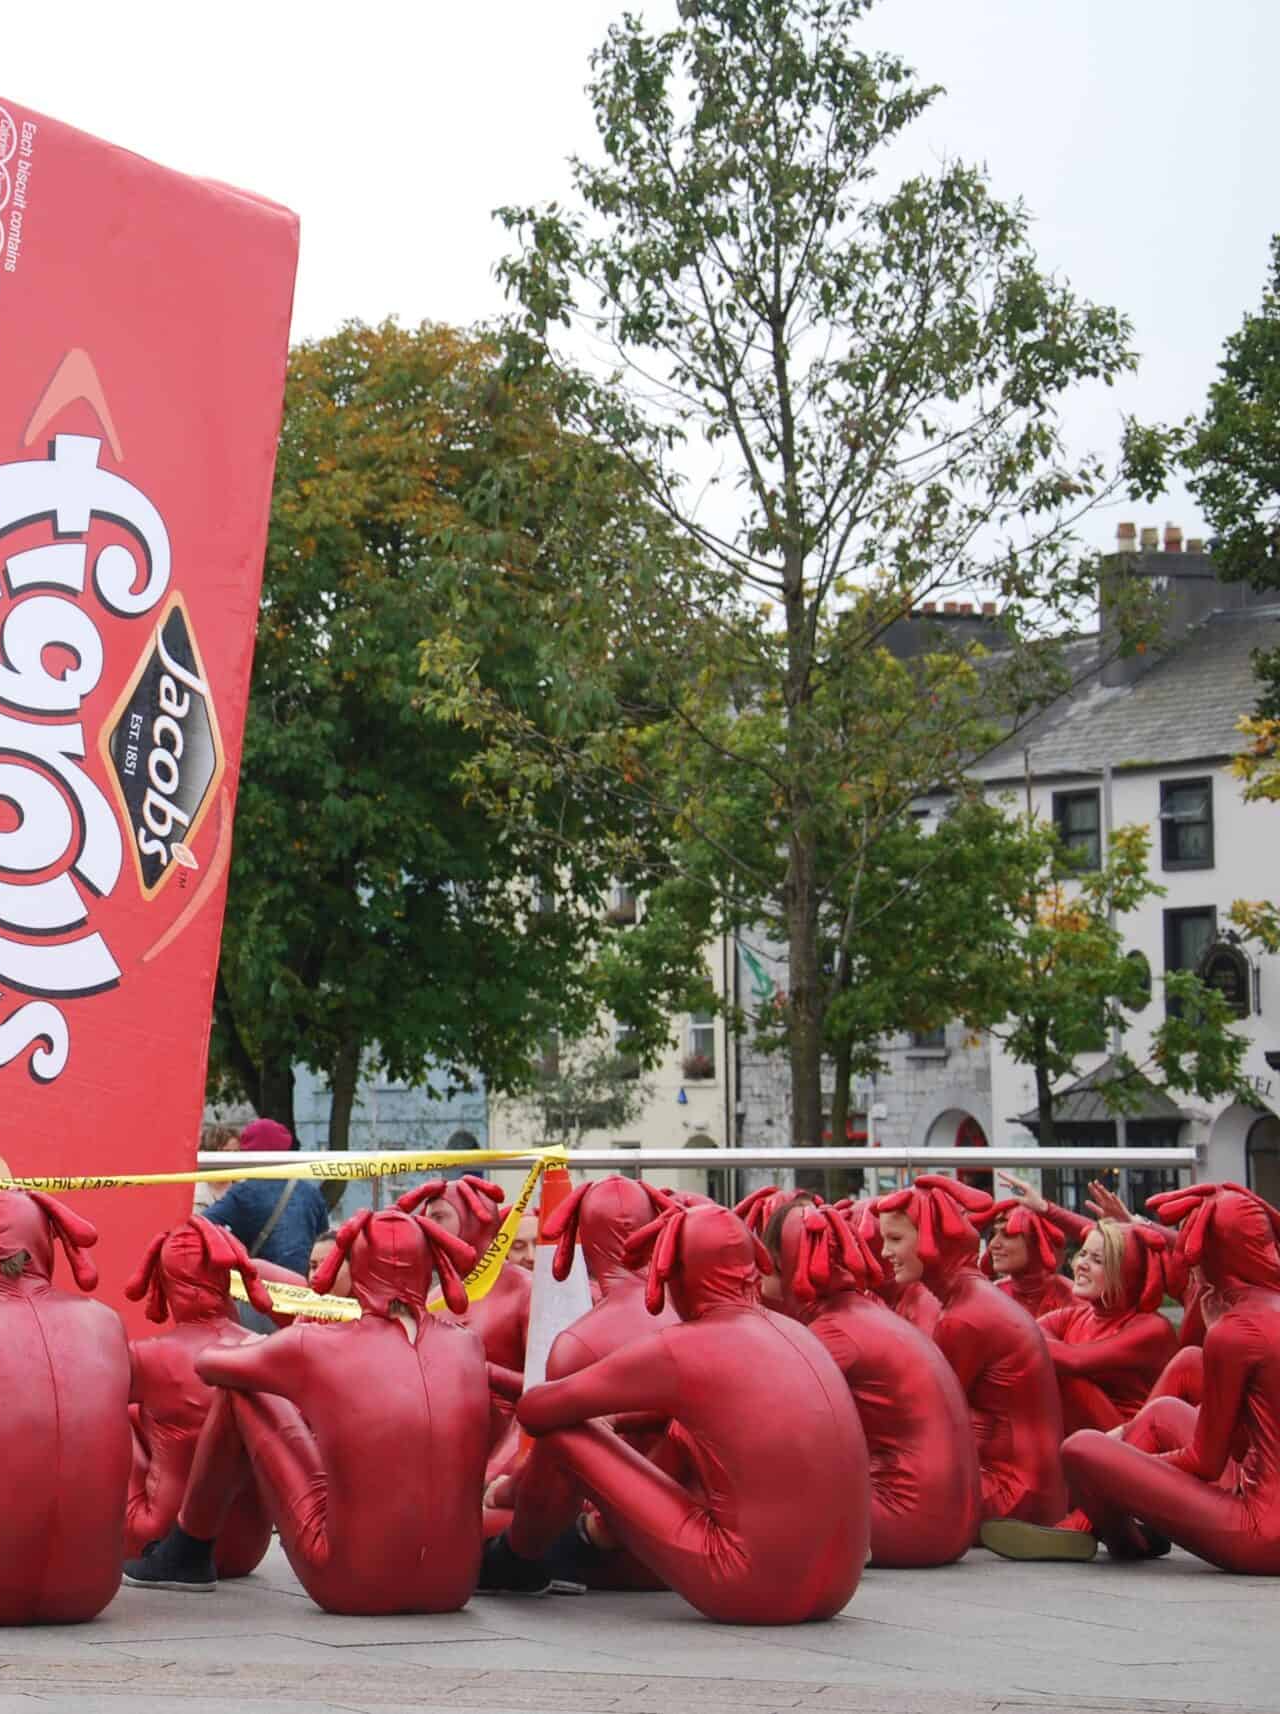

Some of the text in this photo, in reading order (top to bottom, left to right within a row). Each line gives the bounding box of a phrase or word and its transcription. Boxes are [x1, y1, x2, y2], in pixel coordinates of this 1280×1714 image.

[4, 120, 37, 272] Each biscuit contains
[123, 713, 144, 776] EST. 1851
[310, 1162, 377, 1177] ELECTRIC
